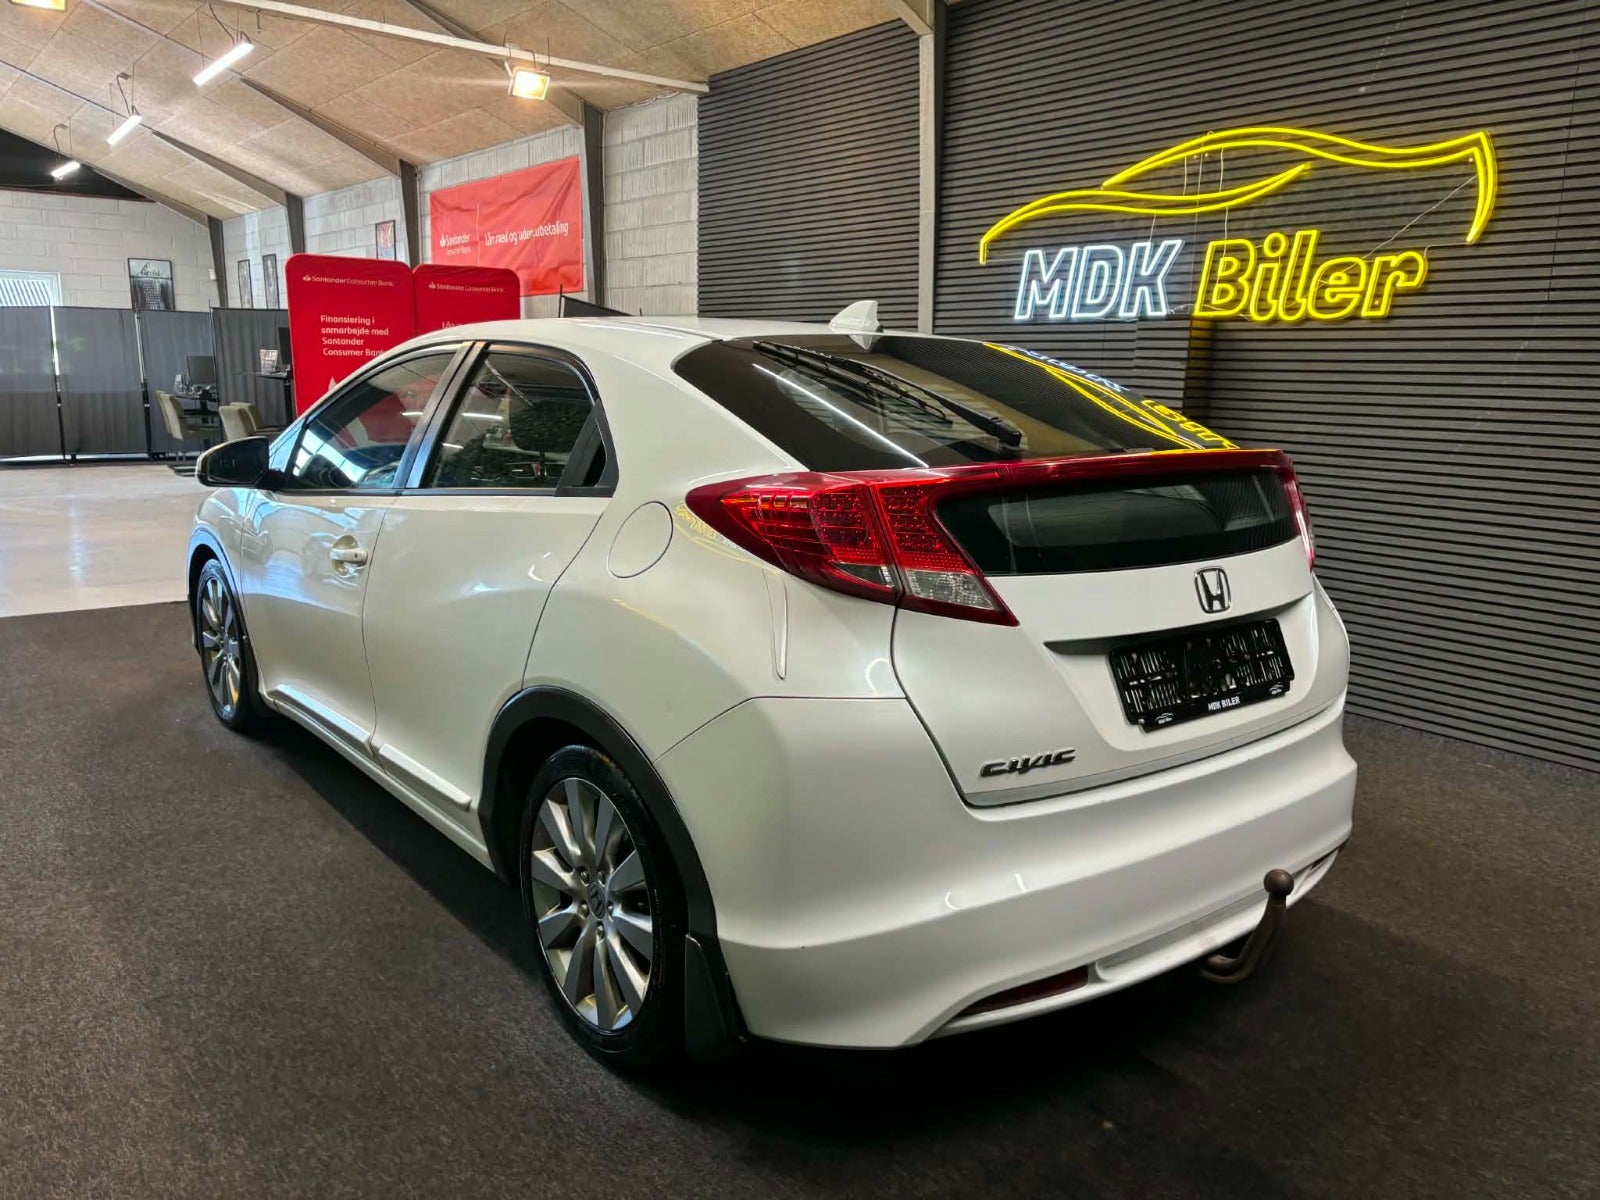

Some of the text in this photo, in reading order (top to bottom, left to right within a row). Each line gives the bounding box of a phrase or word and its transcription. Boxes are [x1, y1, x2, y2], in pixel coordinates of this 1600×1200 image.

[311, 276, 346, 284] Santander
[1012, 229, 1430, 323] MDK Biler
[320, 315, 375, 326] Finansiering i
[321, 327, 389, 336] samarbejde med
[321, 337, 365, 346] Santander
[322, 347, 363, 356] Consumer
[979, 748, 1077, 778] CIVIC
